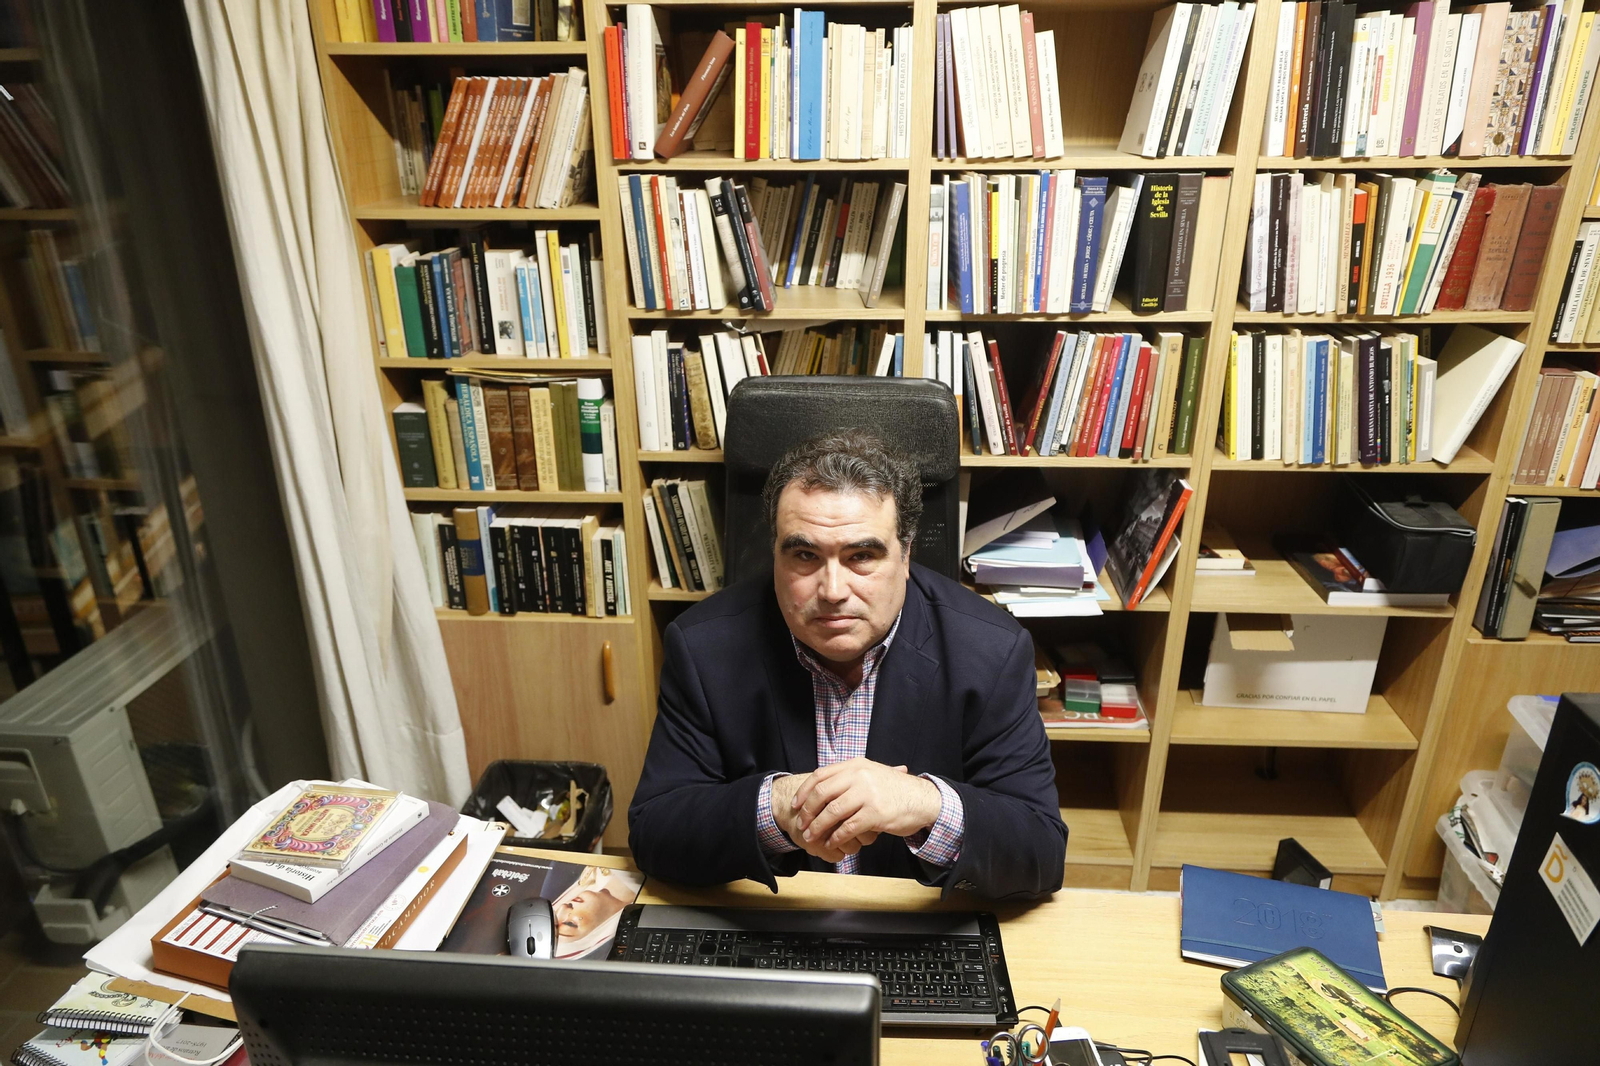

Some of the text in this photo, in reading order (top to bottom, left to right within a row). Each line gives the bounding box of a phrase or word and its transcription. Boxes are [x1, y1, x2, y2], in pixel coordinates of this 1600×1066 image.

[1195, 96, 1207, 126] CONVENTO
[1214, 22, 1225, 48] CARMEN
[1381, 43, 1394, 102] QUEIPO DE LLANO
[1430, 26, 1455, 142] LA CASA DE PILATOS EN EL SIGLO XIX
[899, 90, 905, 100] DE
[1201, 102, 1211, 127] SEVILLA
[1568, 107, 1581, 140] DOLORES
[1299, 134, 1306, 142] La
[1430, 197, 1444, 229] CORONEL
[1175, 235, 1183, 265] CARMELITAS
[1379, 262, 1395, 309] SEVILLA 1936
[1568, 242, 1594, 323] SEVILLA HABLA DE SEVILLA
[1368, 391, 1374, 400] DE
[1571, 385, 1589, 429] Poeta en Sevilla
[1006, 425, 1014, 443] Historia
[1368, 437, 1374, 446] LA
[1550, 453, 1560, 474] SEVILLA
[1561, 422, 1569, 438] LABIOS
[702, 532, 716, 573] LA LITERATURA
[605, 578, 613, 603] ARTISTAS
[387, 827, 403, 840] Historia
[274, 861, 315, 882] Historia de
[490, 867, 530, 883] Soledad
[1232, 896, 1326, 940] 2018
